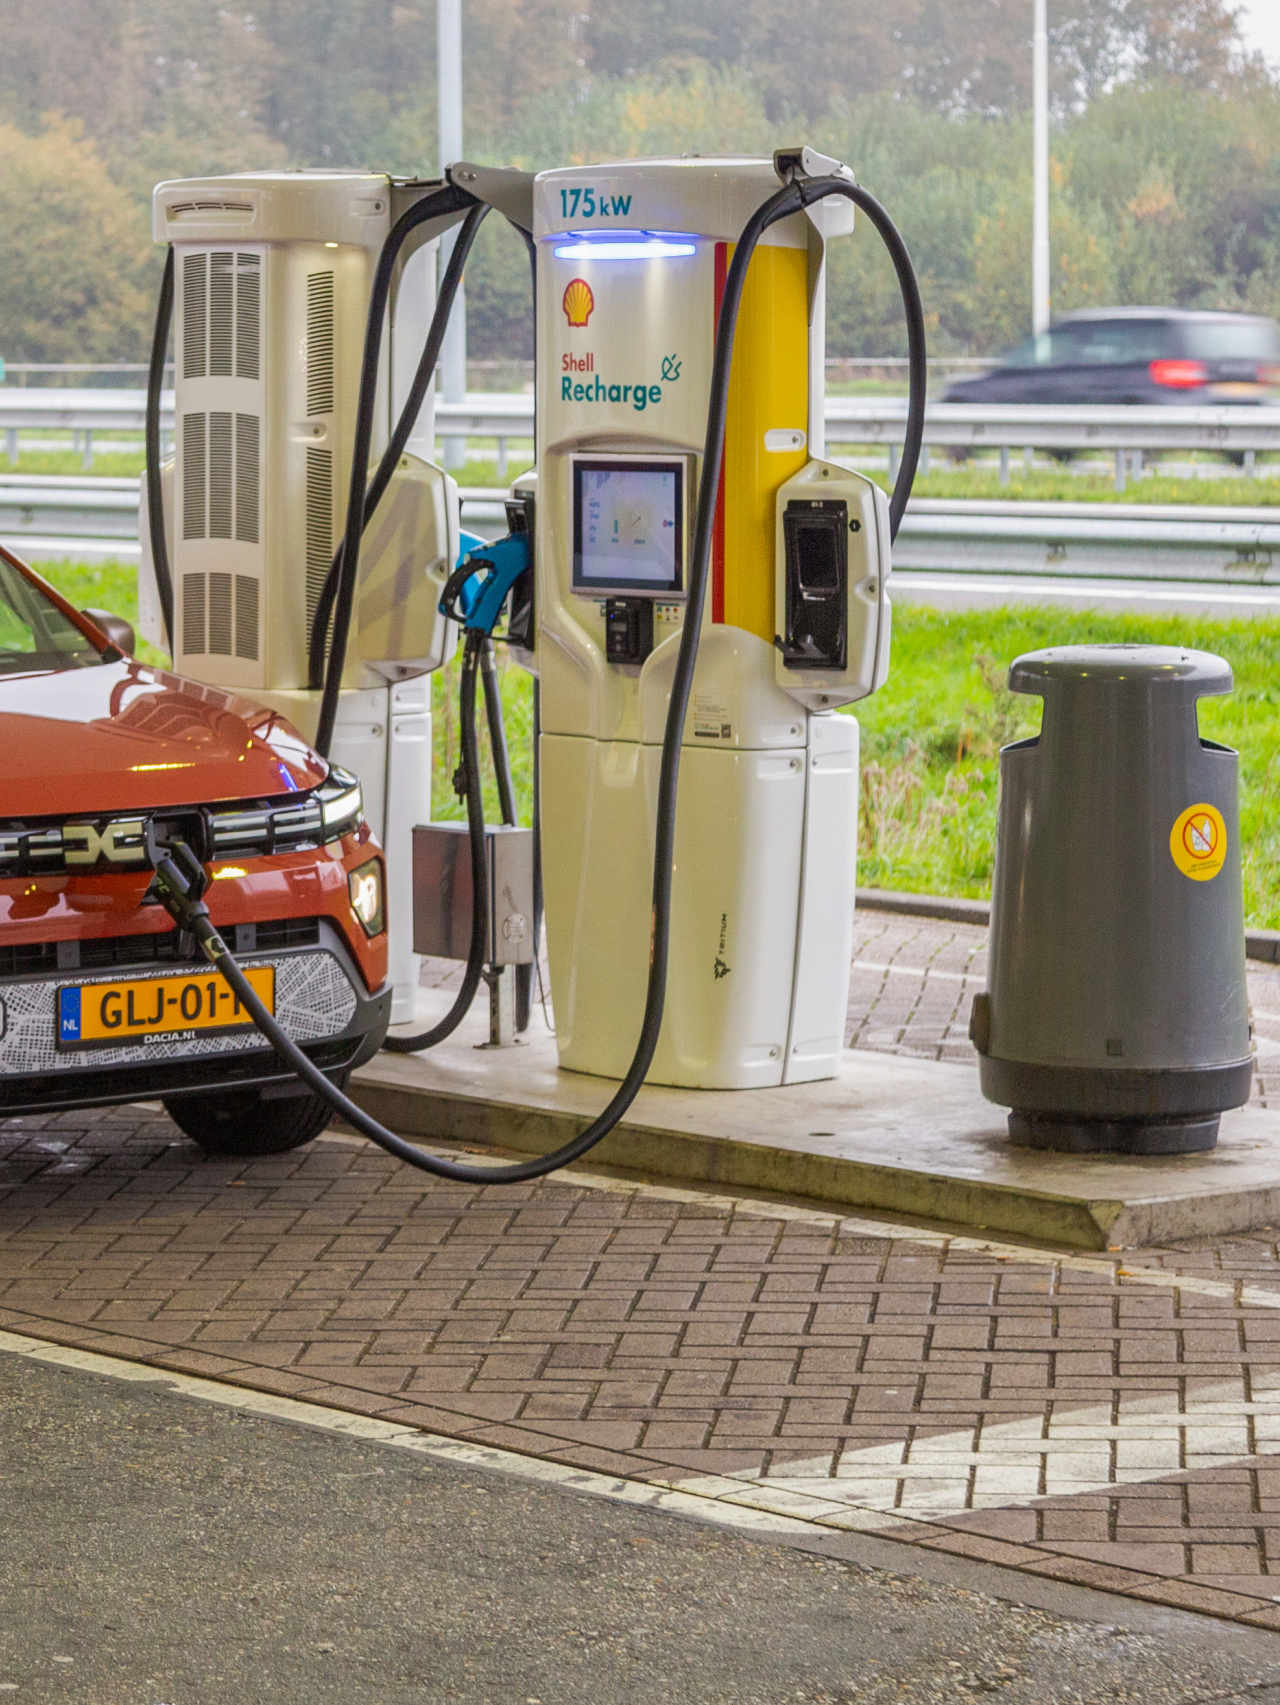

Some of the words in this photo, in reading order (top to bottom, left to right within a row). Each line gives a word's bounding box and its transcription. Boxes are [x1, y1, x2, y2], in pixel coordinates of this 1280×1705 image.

[560, 188, 596, 218] 175
[600, 195, 633, 216] kW
[561, 352, 594, 372] Shell
[561, 374, 662, 411] Recharge
[718, 913, 727, 955] TRITIUM
[99, 981, 252, 1029] GLJ-01-
[62, 1018, 79, 1032] NL
[142, 1029, 198, 1045] DACIA.NL
